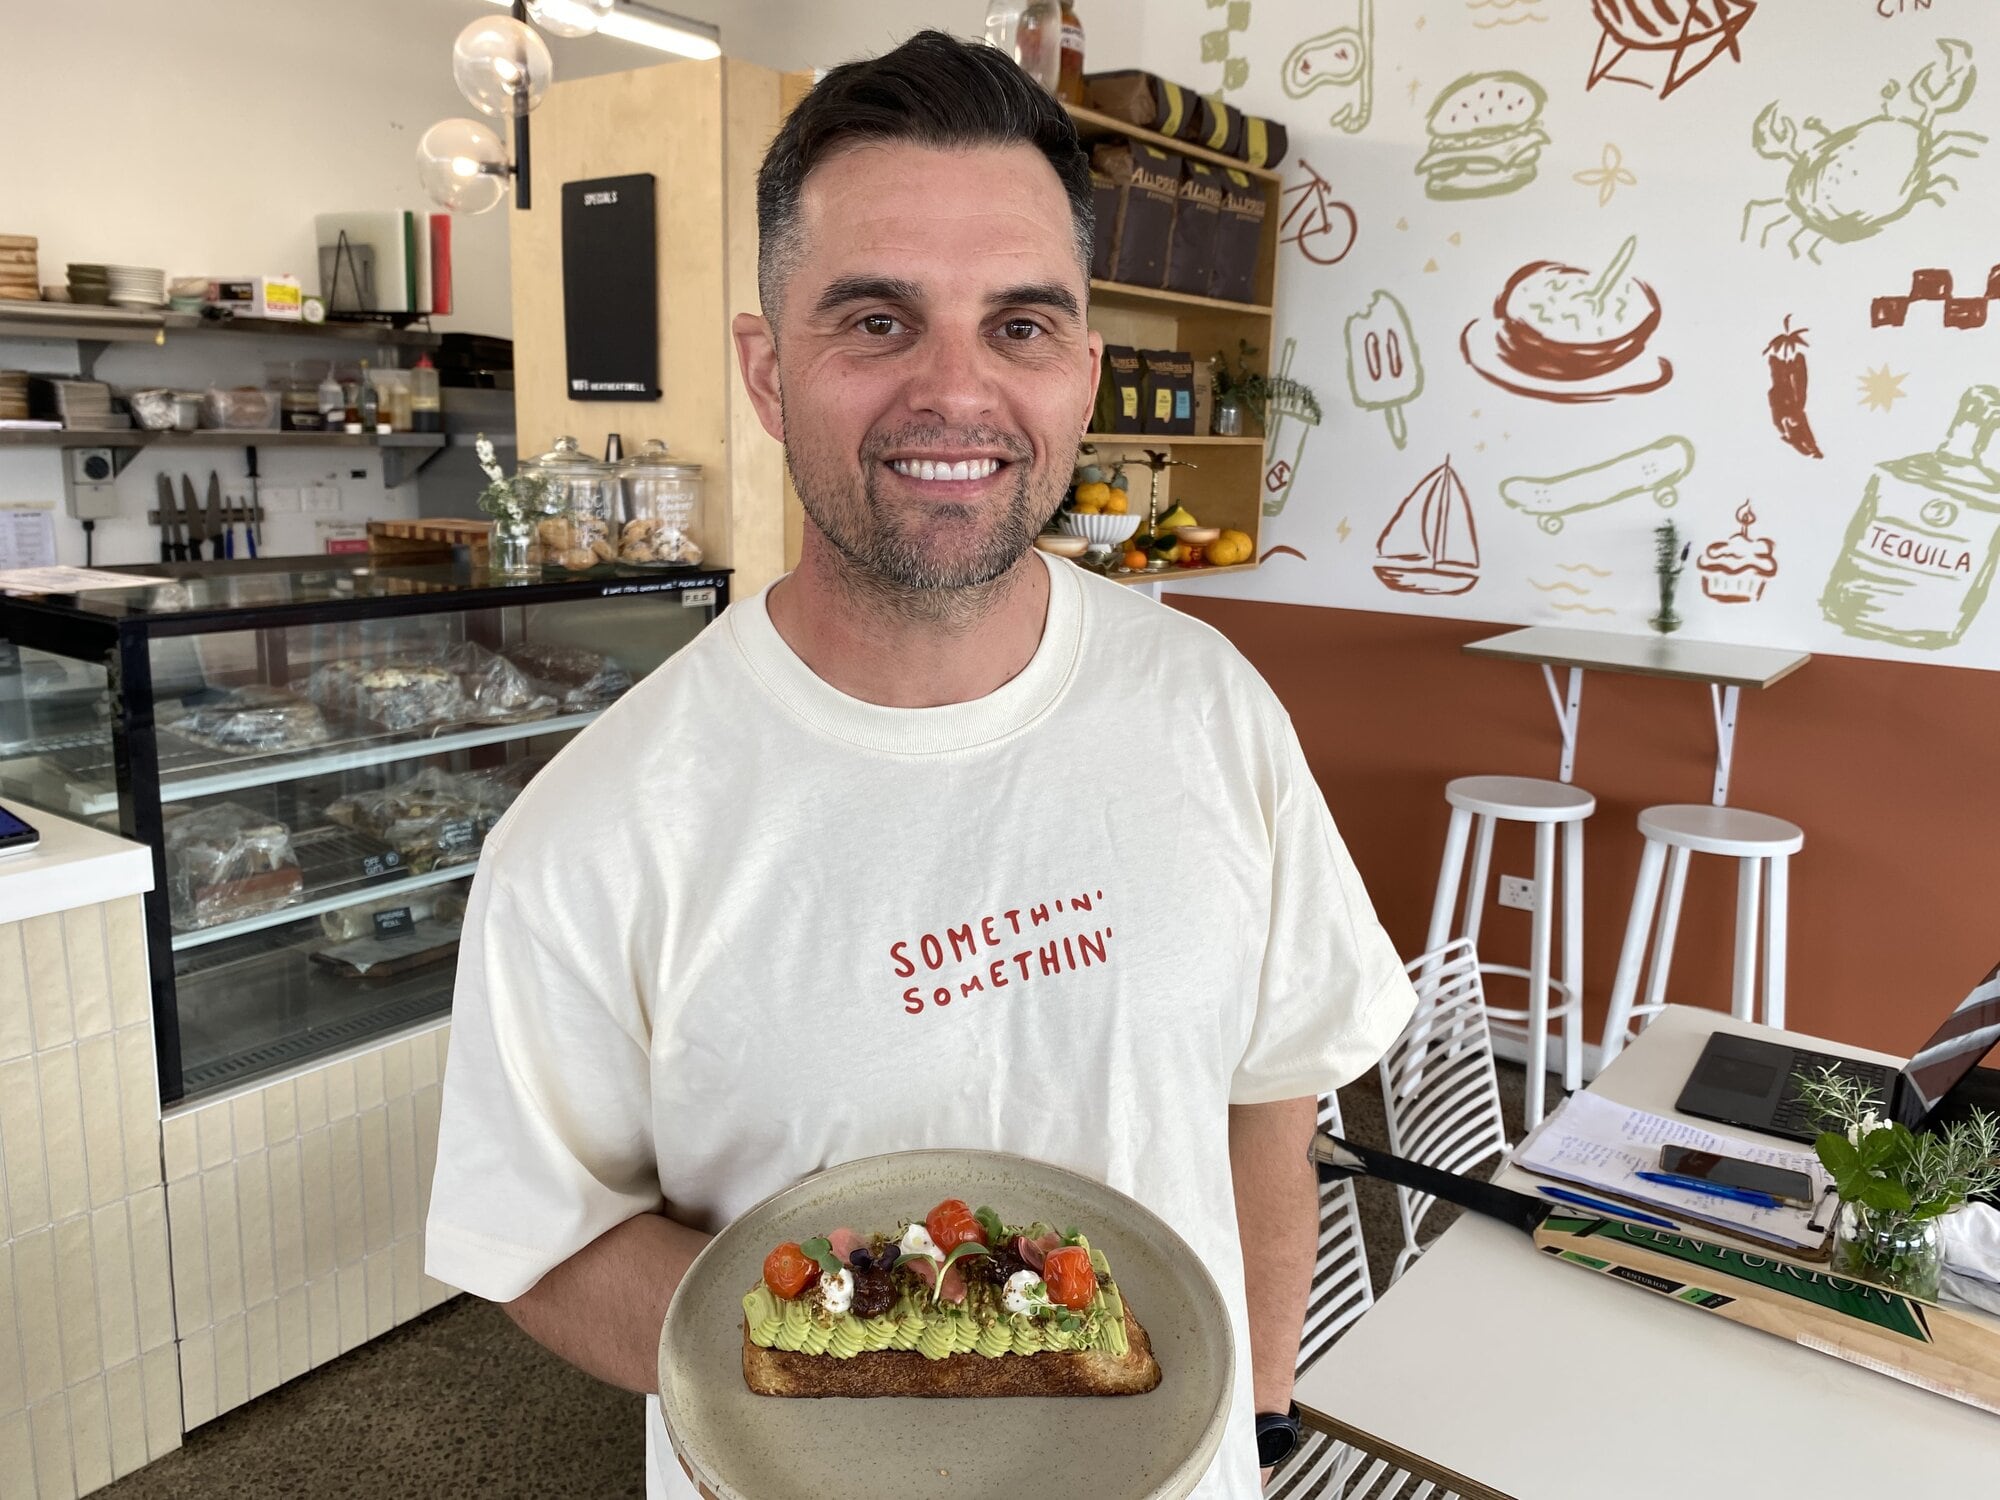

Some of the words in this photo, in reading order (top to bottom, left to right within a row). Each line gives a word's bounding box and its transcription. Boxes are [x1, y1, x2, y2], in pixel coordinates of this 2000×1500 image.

[1871, 526, 1971, 573] TEQUILA
[890, 890, 1103, 978] SOMETHIN'
[903, 927, 1113, 1015] SOMETHIN'
[1621, 1269, 1669, 1291] CENTURION
